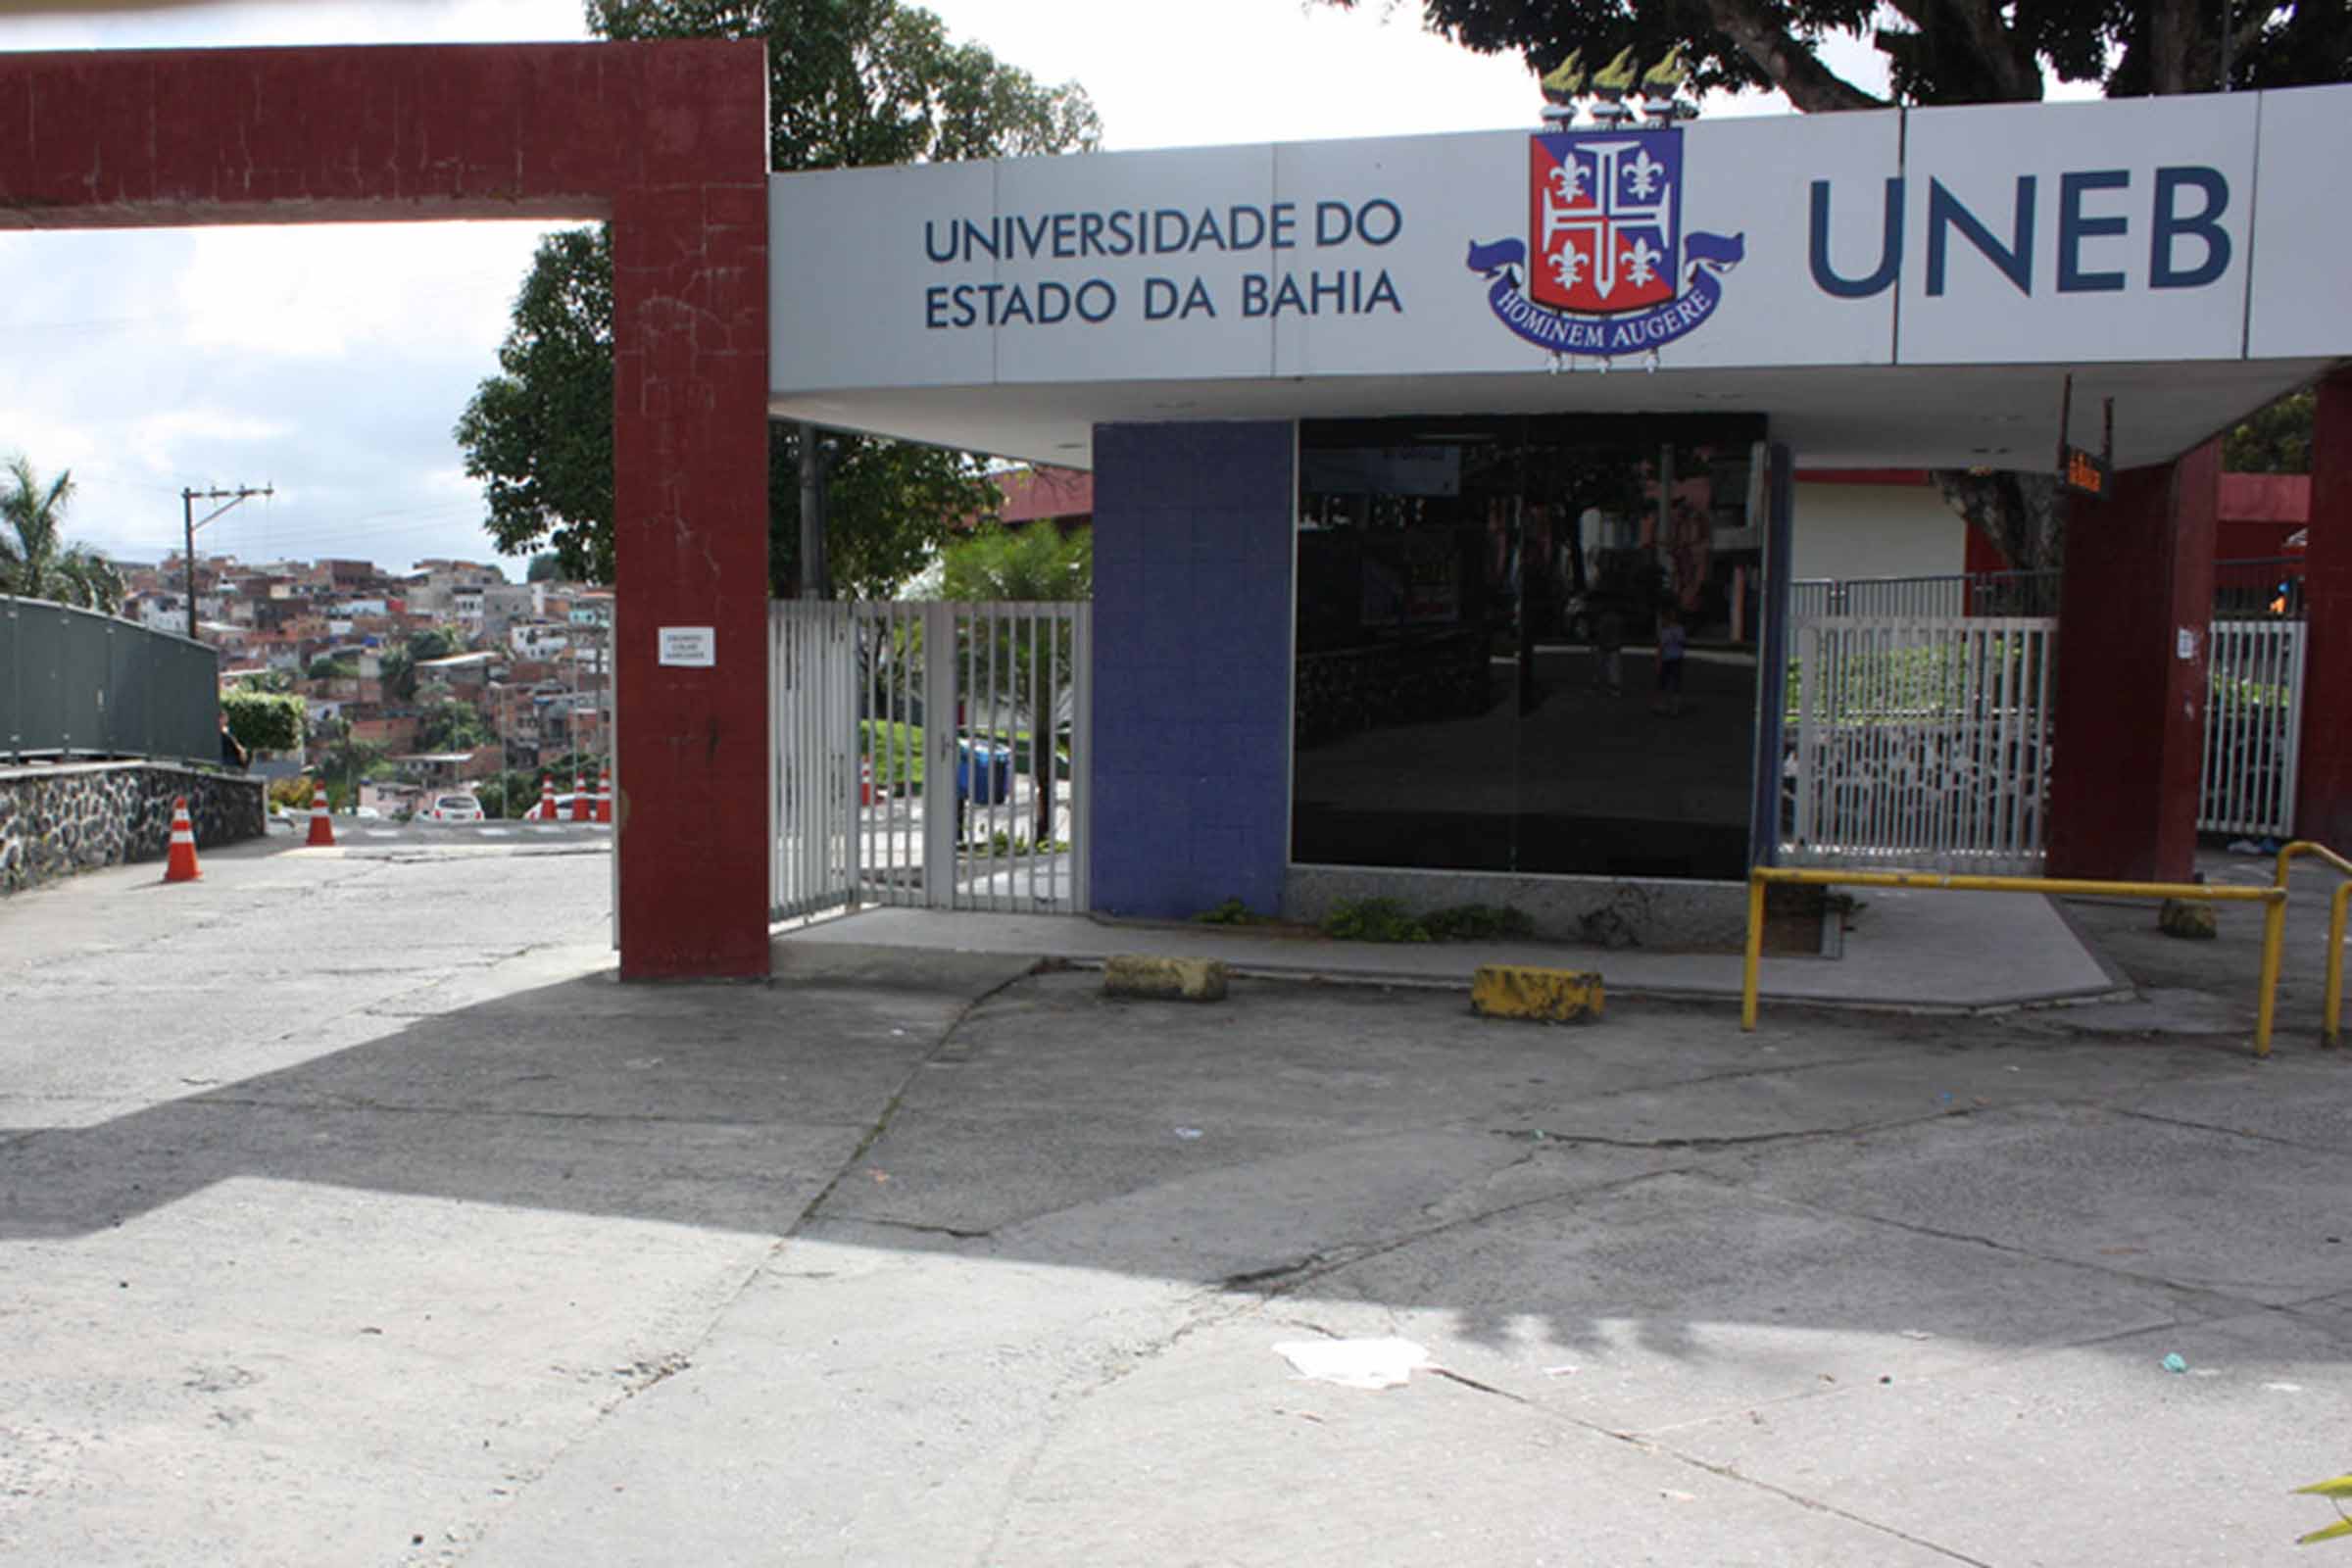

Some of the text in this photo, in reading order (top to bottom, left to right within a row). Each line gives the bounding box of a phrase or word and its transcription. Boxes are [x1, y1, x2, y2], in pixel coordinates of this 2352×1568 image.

[925, 198, 1402, 263] UNIVERSIDADE DO
[1808, 166, 2232, 299] UNEB
[925, 269, 1402, 329] ESTADO DA BAHIA
[1497, 288, 1712, 348] HOMINEM AUGERE
